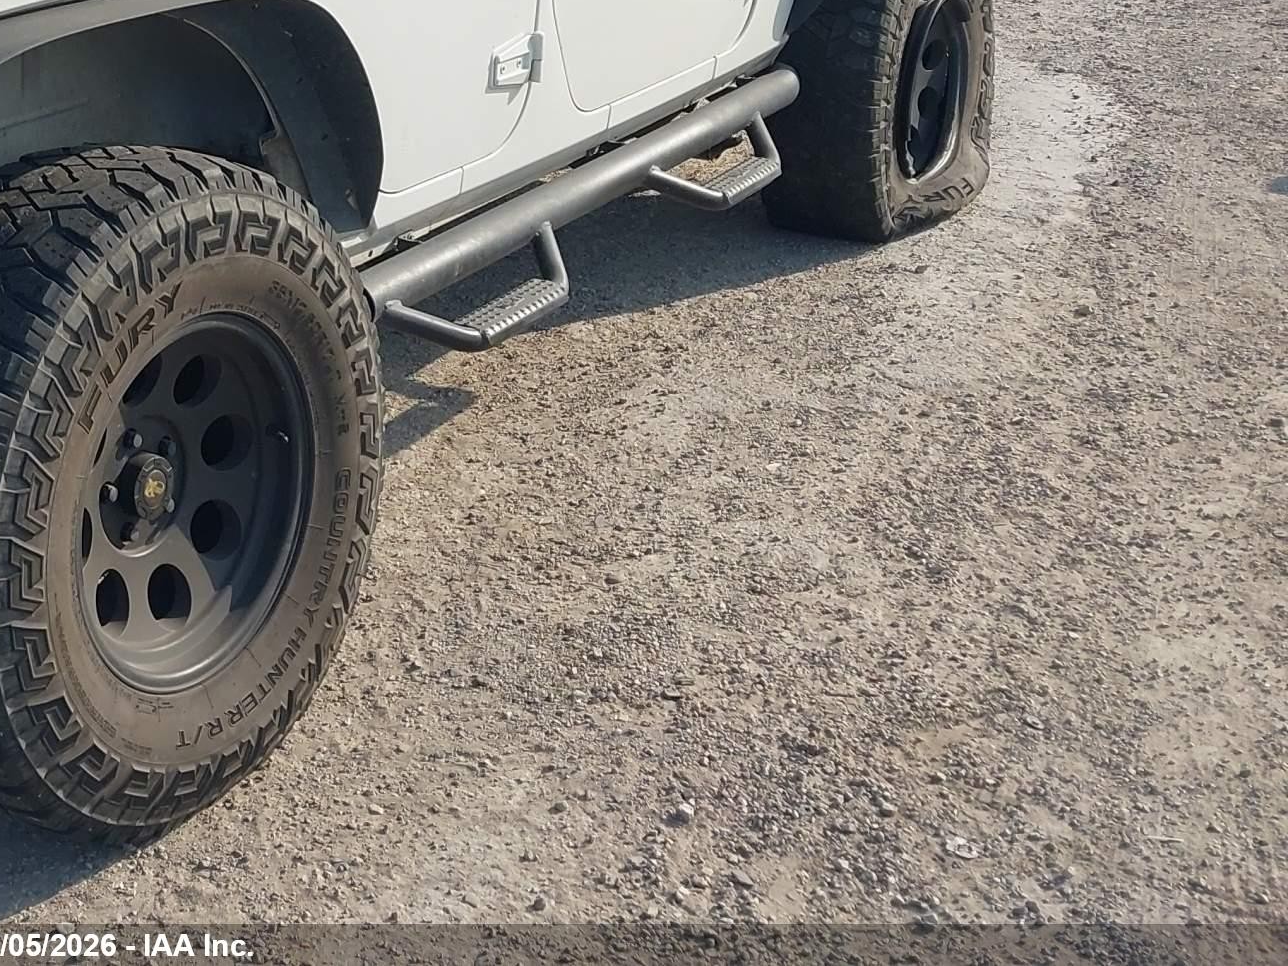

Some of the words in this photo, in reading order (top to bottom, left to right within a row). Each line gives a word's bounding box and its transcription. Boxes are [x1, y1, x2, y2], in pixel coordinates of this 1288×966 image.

[78, 281, 183, 434] FURY
[304, 467, 352, 625] COUNTRY
[175, 720, 224, 751] R/T
[220, 626, 308, 725] HUNTER
